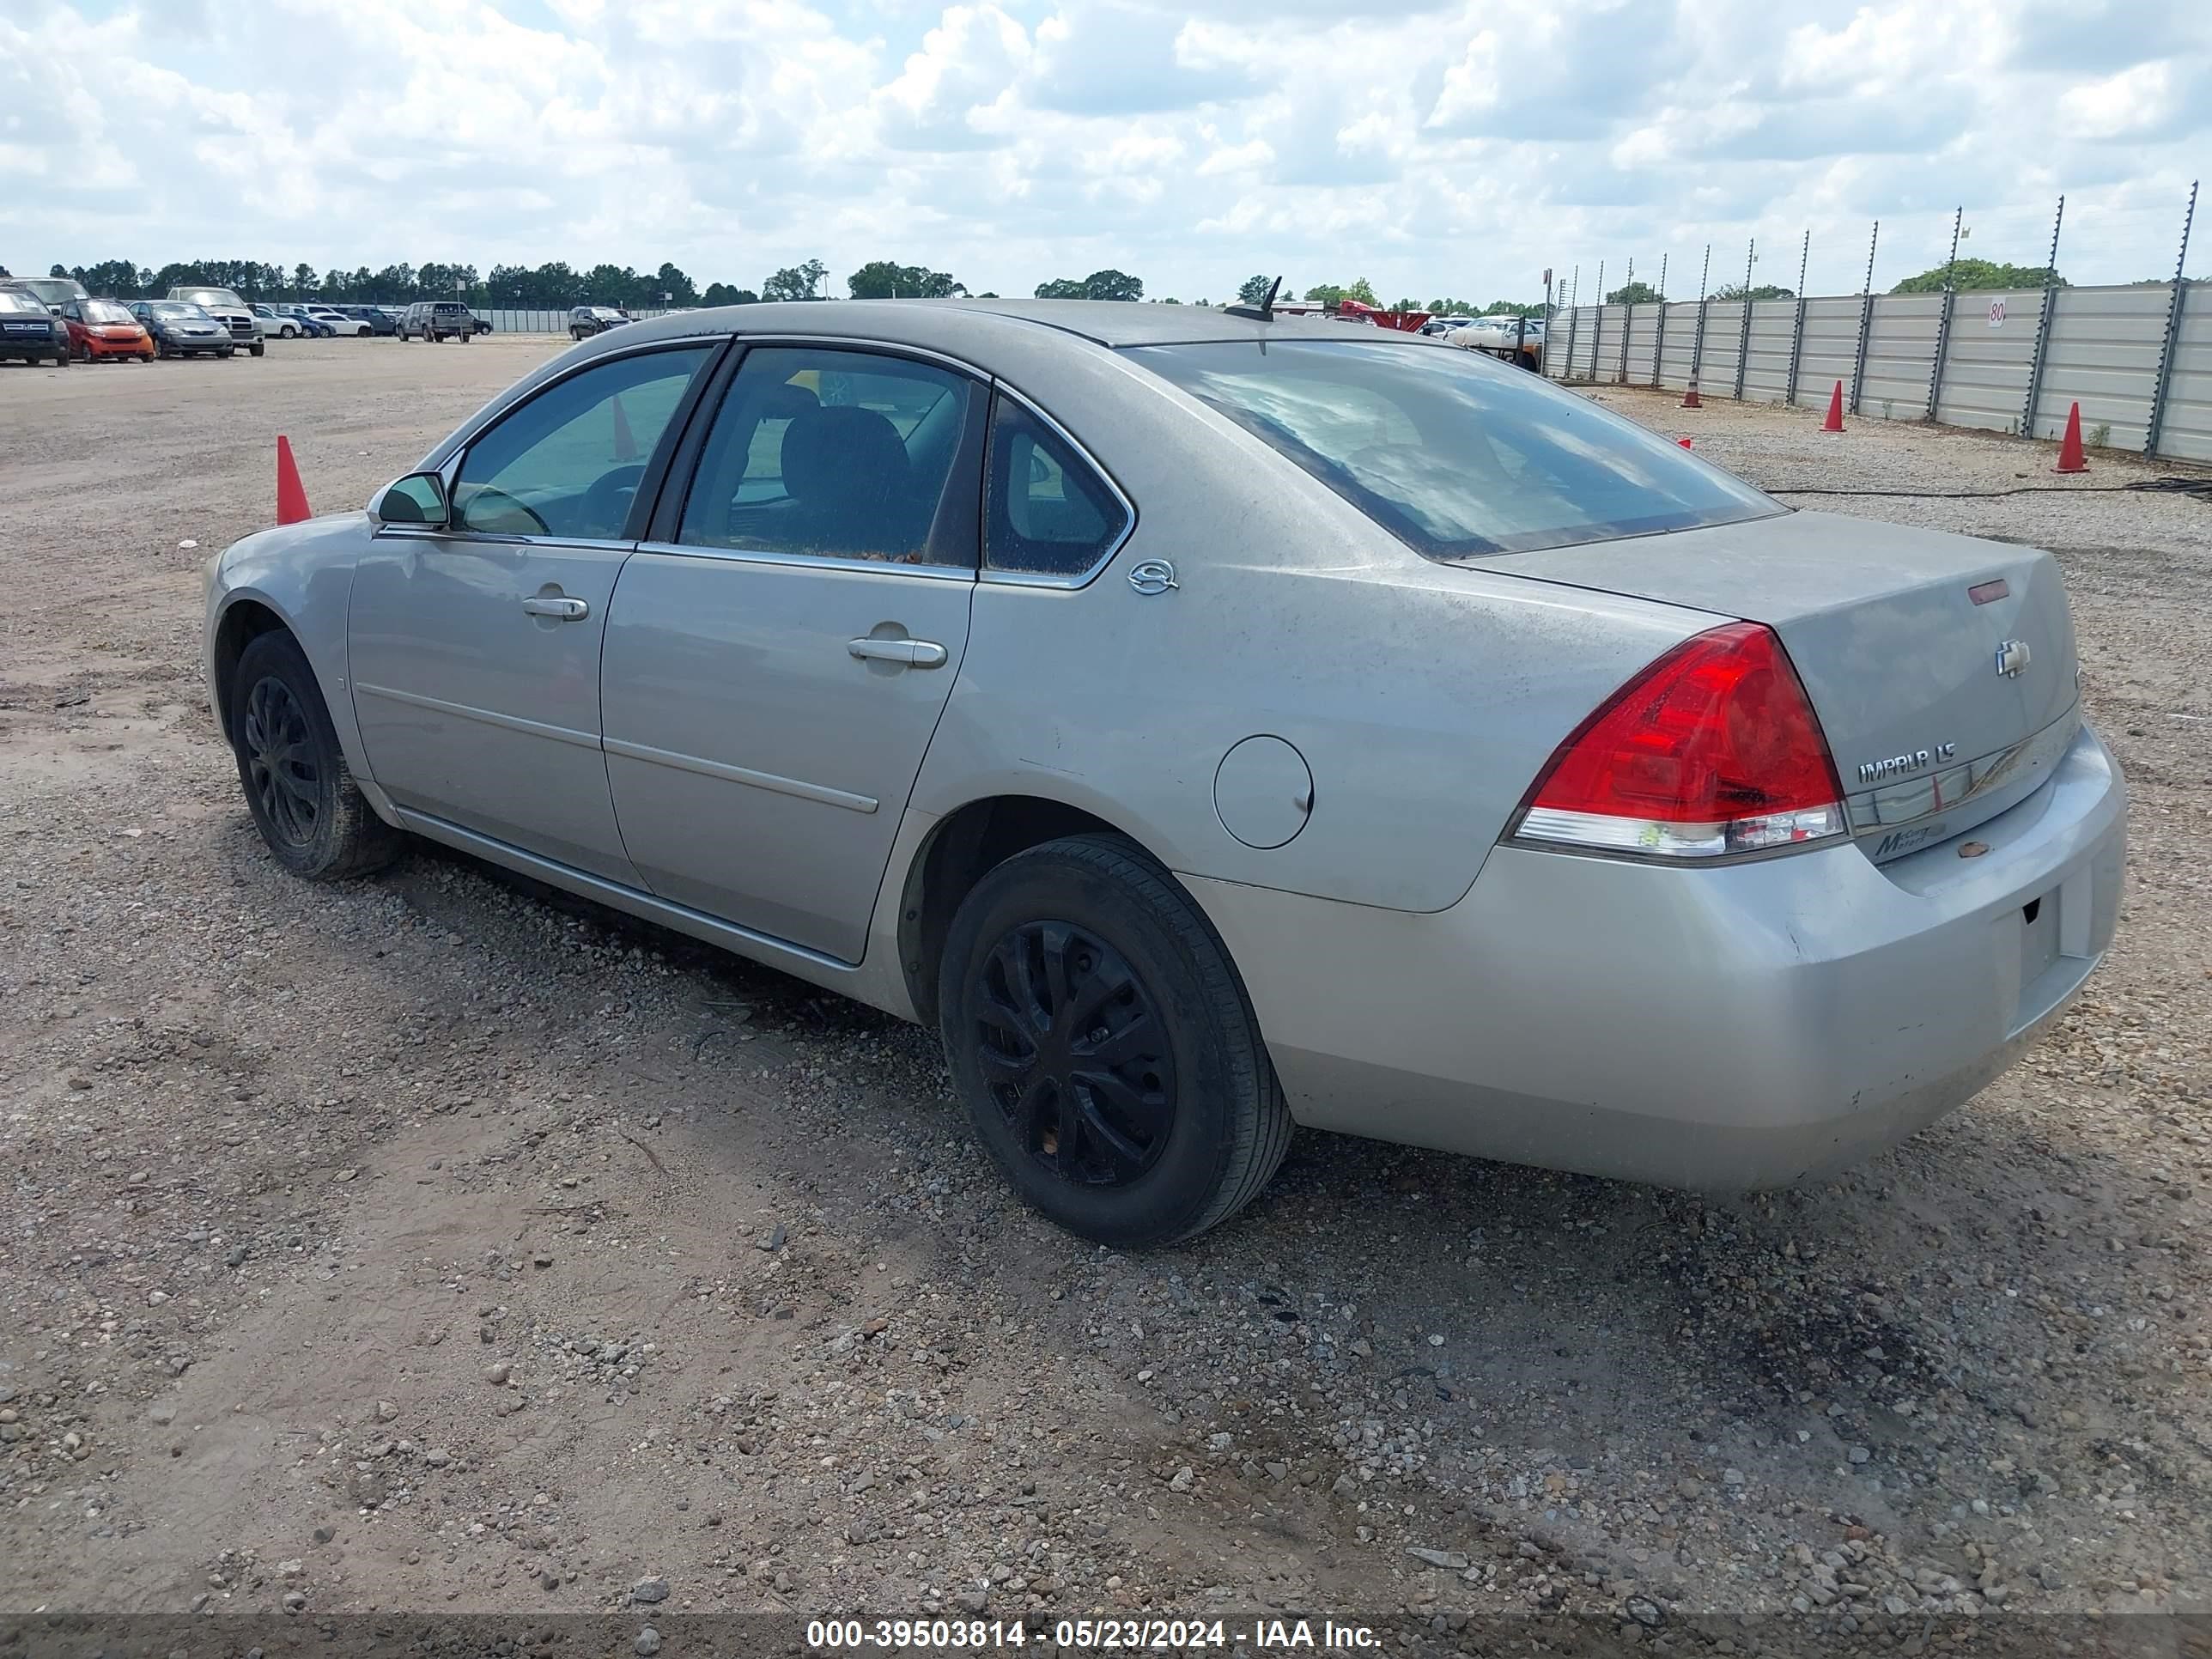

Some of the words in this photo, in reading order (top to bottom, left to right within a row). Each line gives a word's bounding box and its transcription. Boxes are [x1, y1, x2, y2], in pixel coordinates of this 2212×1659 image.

[1990, 302, 2003, 321] 80
[1858, 750, 1929, 783] IMPALA
[1936, 743, 1955, 763] LS
